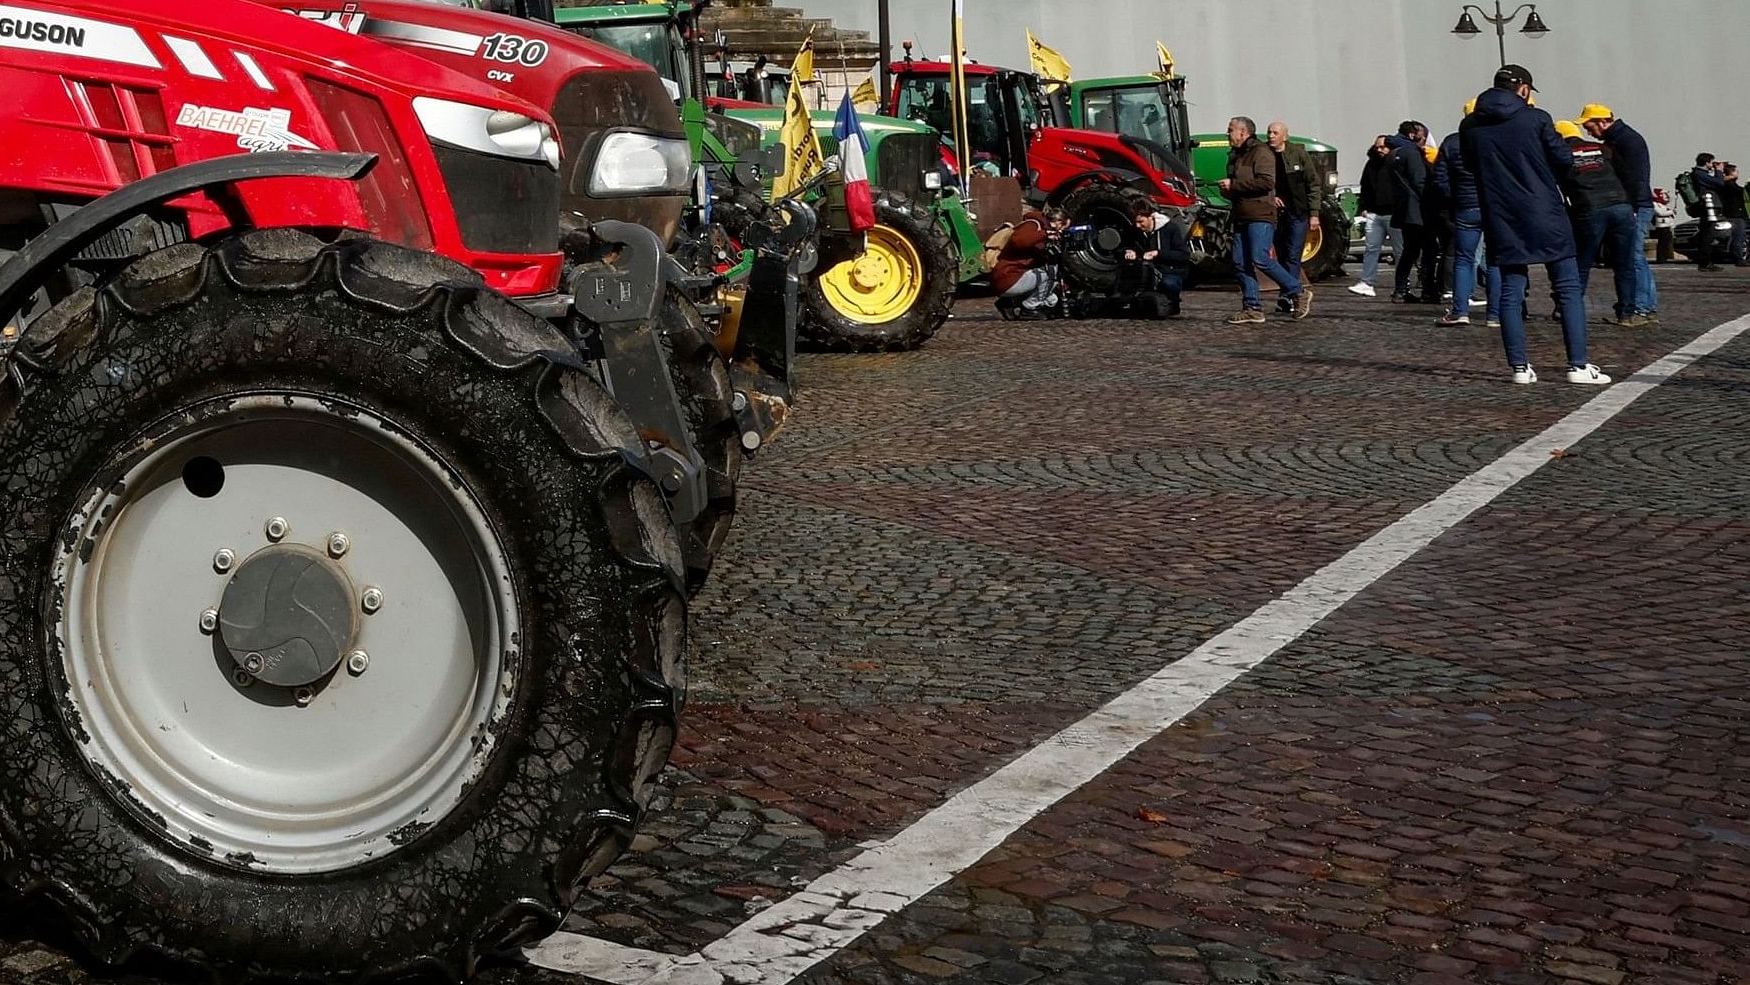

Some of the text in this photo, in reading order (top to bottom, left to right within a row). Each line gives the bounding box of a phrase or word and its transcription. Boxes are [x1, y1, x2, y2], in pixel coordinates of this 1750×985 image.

[482, 32, 549, 67] 130
[487, 69, 515, 83] CVX
[179, 107, 268, 137] BAEHREL
[238, 136, 285, 153] agri
